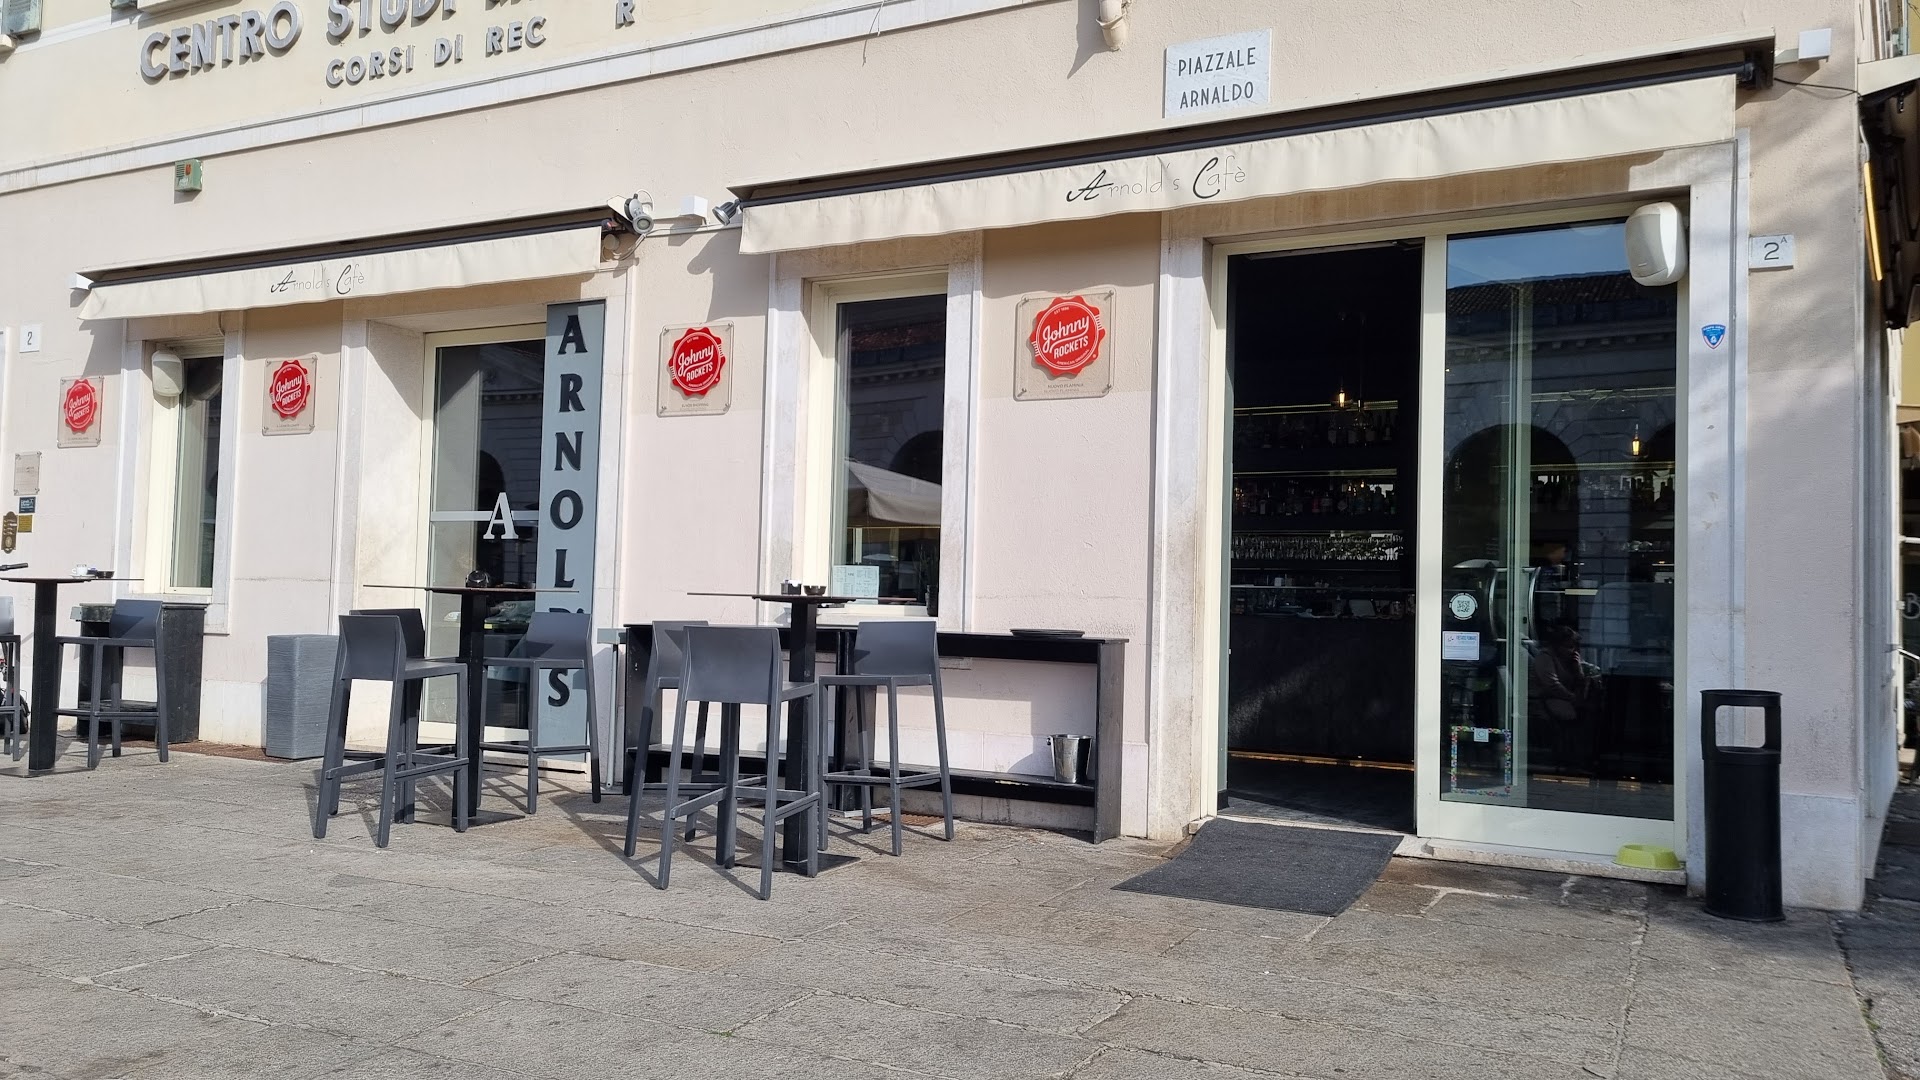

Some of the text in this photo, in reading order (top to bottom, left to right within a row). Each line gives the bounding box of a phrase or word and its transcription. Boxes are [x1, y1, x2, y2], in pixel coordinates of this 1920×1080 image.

[140, 1, 303, 80] CENTRO
[326, 45, 415, 86] CORSI
[434, 34, 463, 64] DI
[1178, 47, 1256, 77] PIAZZALE
[1180, 81, 1254, 109] ARNALDO
[1066, 162, 1181, 202] Arnold's
[270, 265, 330, 293] Arnold's
[27, 331, 33, 346] 2
[1042, 315, 1089, 354] Johnny
[1054, 336, 1089, 359] ROCKETS
[678, 345, 714, 377] Johnny
[686, 362, 713, 382] ROCKETS
[276, 374, 302, 402] Johnny
[281, 389, 302, 406] ROCKETS
[69, 393, 90, 417] Johnny
[73, 405, 90, 420] ROCKETS
[482, 491, 519, 541] A
[547, 314, 588, 708] ARNOLS
